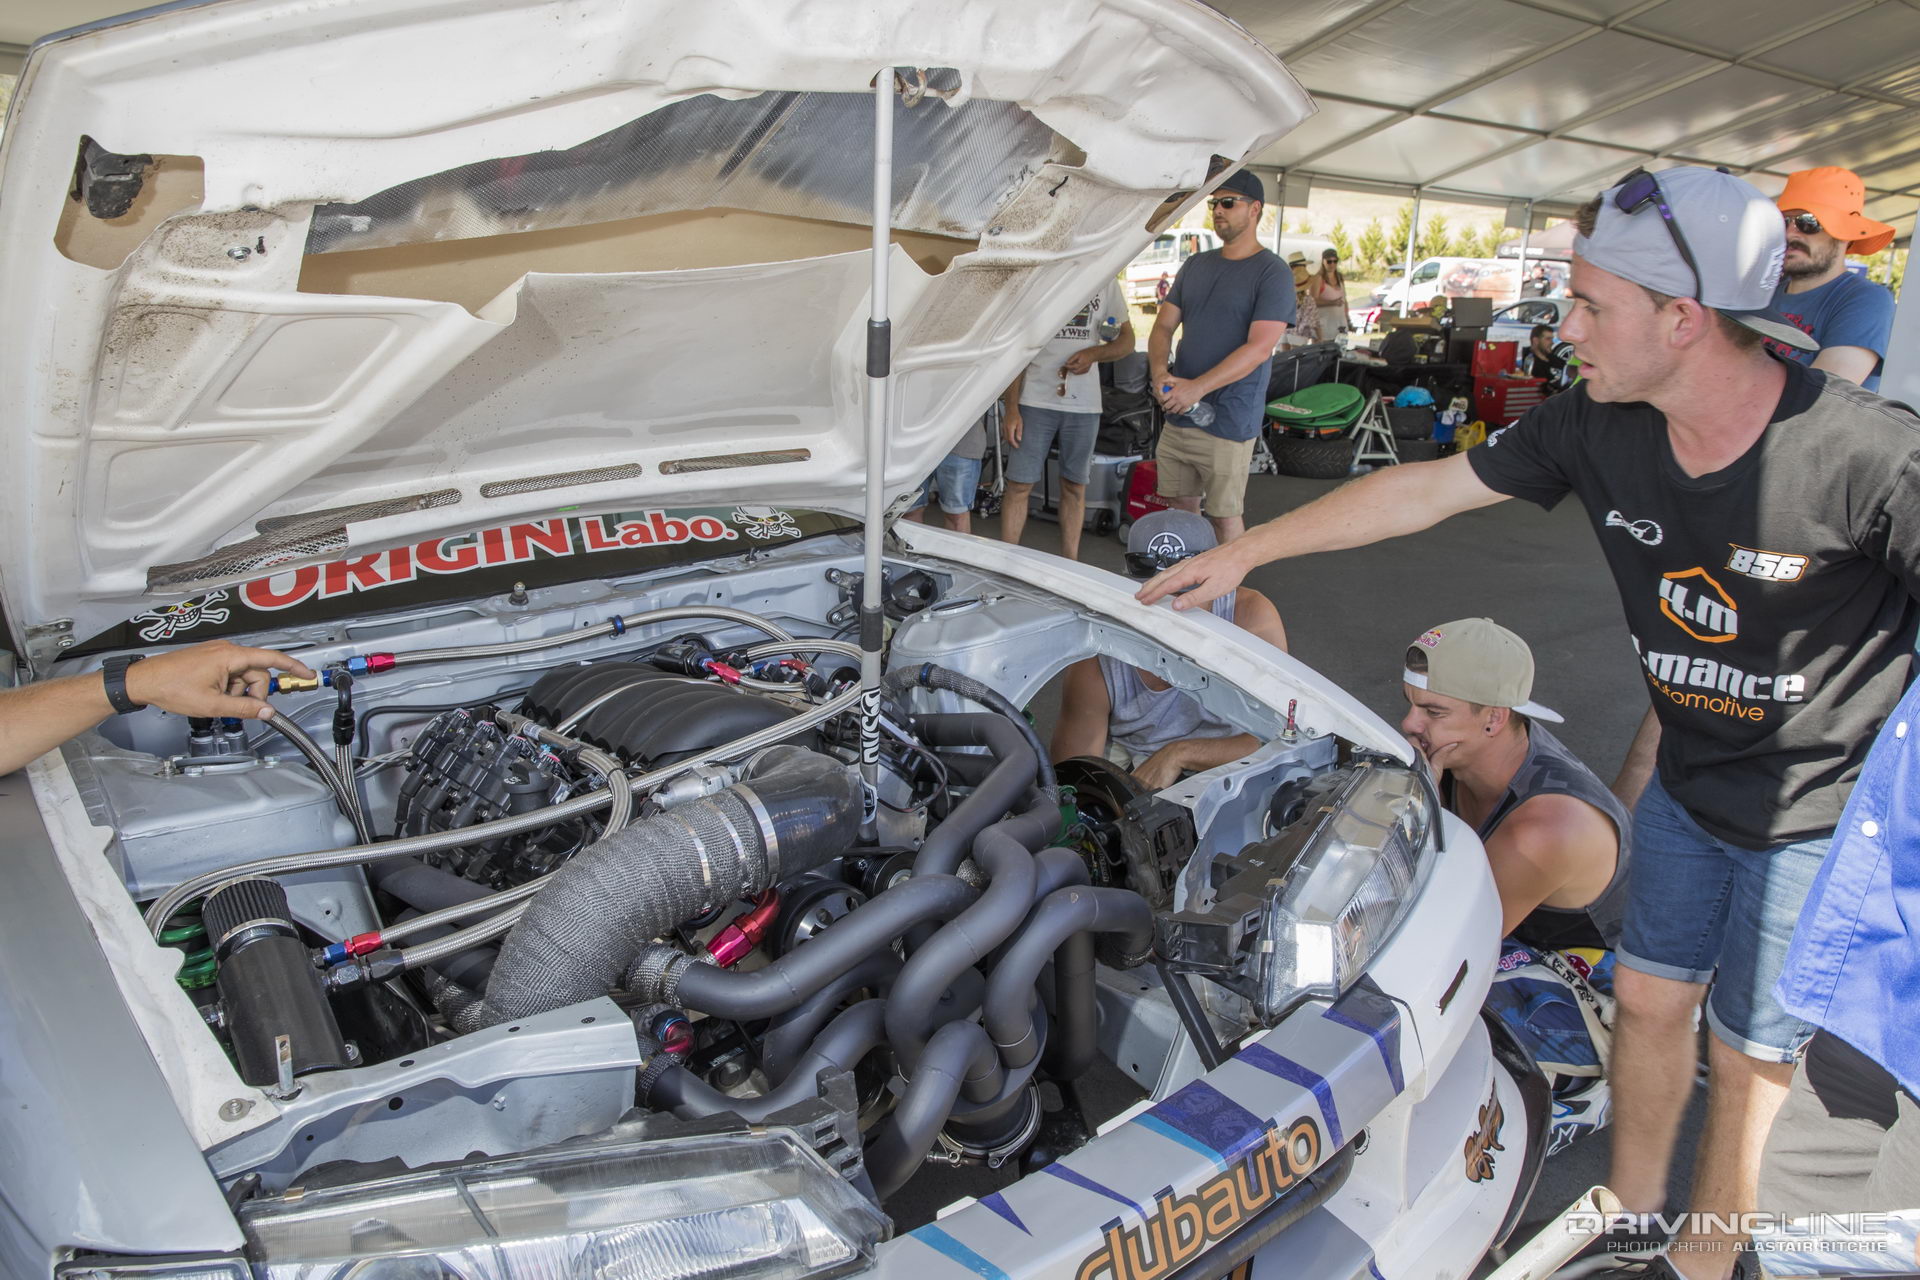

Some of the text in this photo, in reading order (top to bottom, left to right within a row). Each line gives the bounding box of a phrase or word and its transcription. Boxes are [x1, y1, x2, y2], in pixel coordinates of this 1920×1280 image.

[239, 509, 739, 611] ORIGIN Labo.
[1729, 549, 1806, 580] 856
[1648, 673, 1764, 720] automotive
